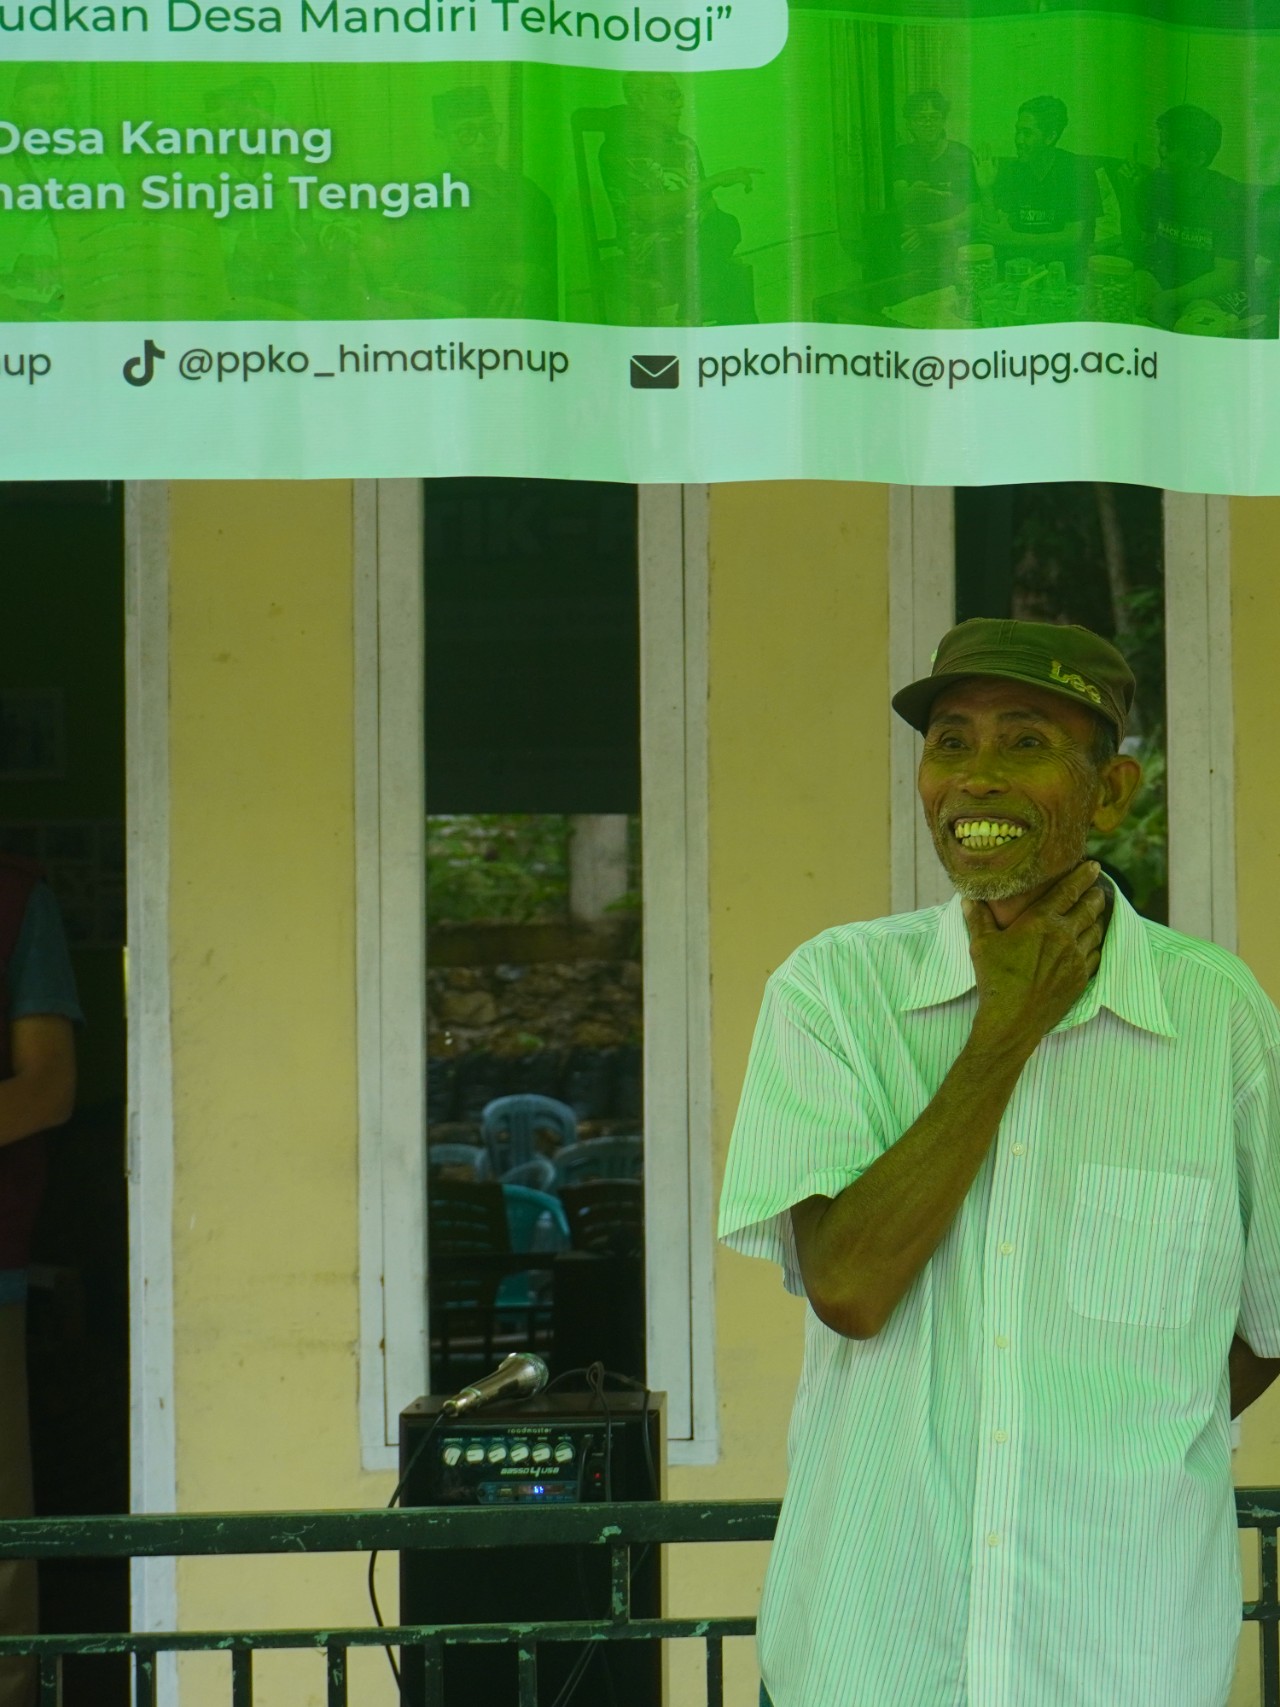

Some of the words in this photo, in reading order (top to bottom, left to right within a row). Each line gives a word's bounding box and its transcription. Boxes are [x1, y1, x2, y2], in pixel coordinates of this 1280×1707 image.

[0, 0, 149, 32] udkan
[168, 0, 282, 33] Desa
[301, 0, 476, 33] Mandiri
[122, 120, 332, 164] Kanrung
[141, 171, 273, 219] Sinjai
[287, 172, 470, 218] Tengah
[3, 353, 52, 386] up
[178, 341, 570, 383] @ppko_himatikpnup
[698, 344, 1158, 390] ppkohimatik@poliupg.ac.id
